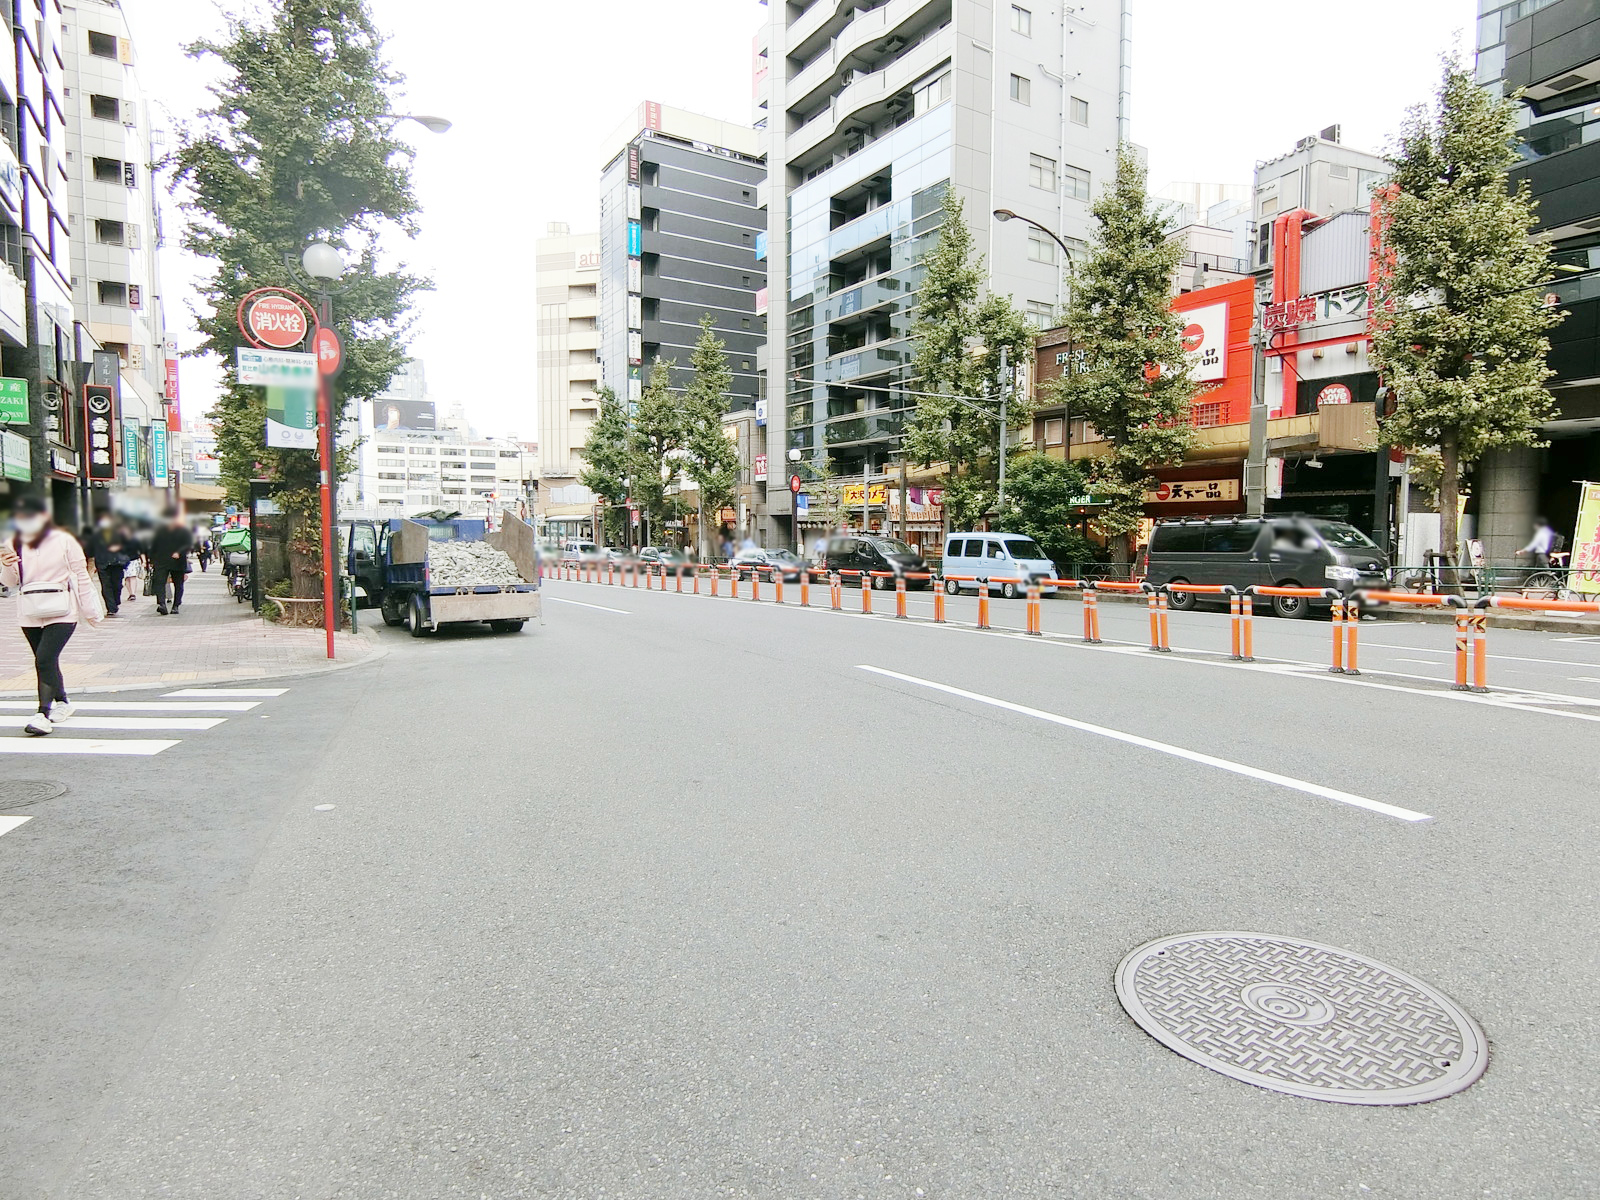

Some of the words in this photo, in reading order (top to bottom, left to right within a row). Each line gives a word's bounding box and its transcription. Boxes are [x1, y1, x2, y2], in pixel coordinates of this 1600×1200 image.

[271, 303, 295, 311] HYDRANT
[255, 311, 302, 333] 消火栓
[305, 411, 313, 428] 2020
[1171, 482, 1221, 499] 天下一品
